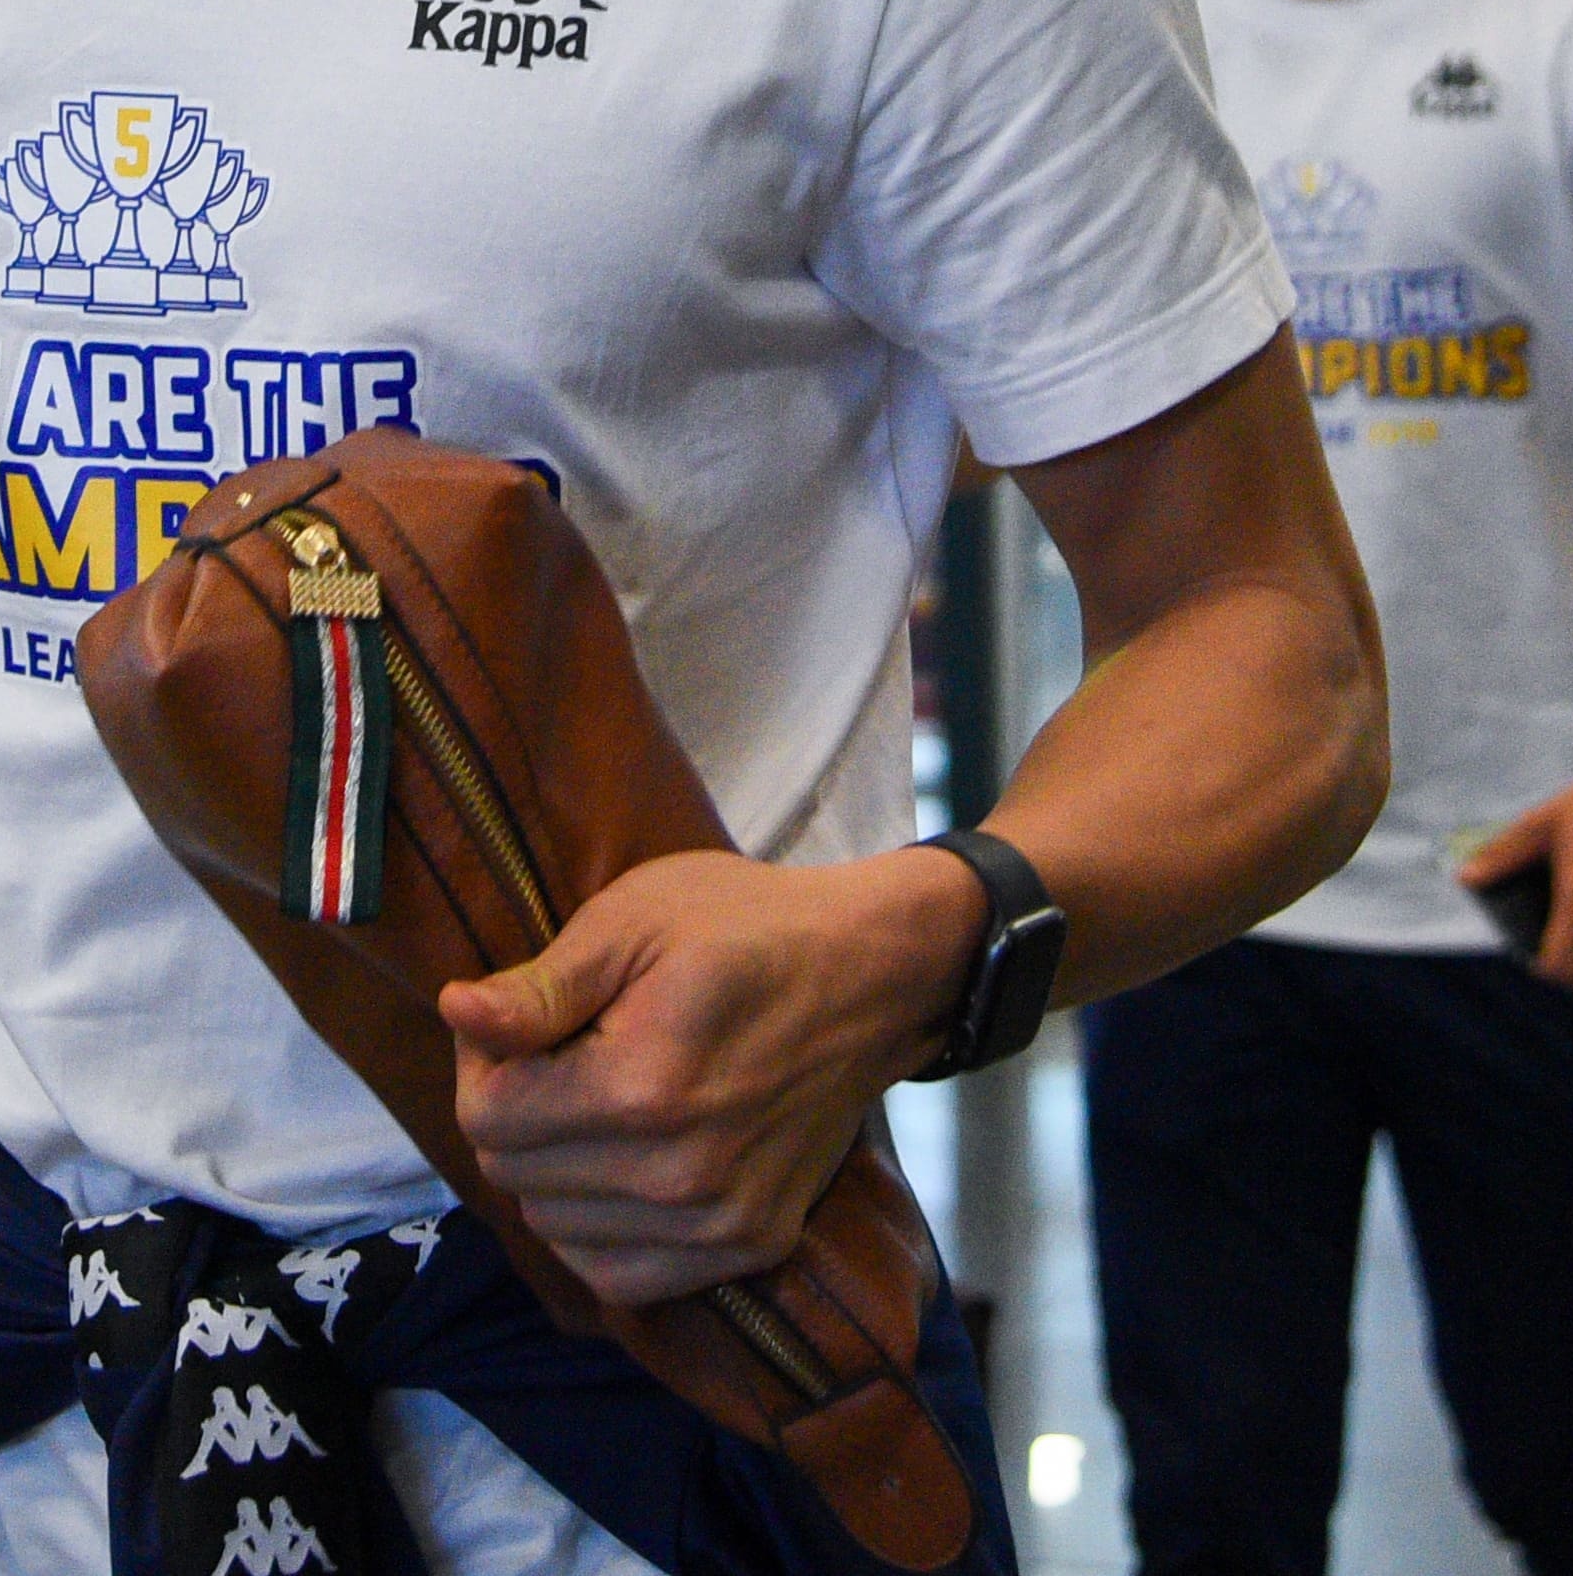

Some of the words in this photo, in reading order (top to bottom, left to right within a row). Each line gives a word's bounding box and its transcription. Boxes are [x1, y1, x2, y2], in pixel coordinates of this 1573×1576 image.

[406, 0, 589, 70] Kappa
[113, 108, 152, 178] 5
[1298, 317, 1530, 402] PIONS
[7, 339, 213, 462] ARE
[226, 349, 421, 462] THE
